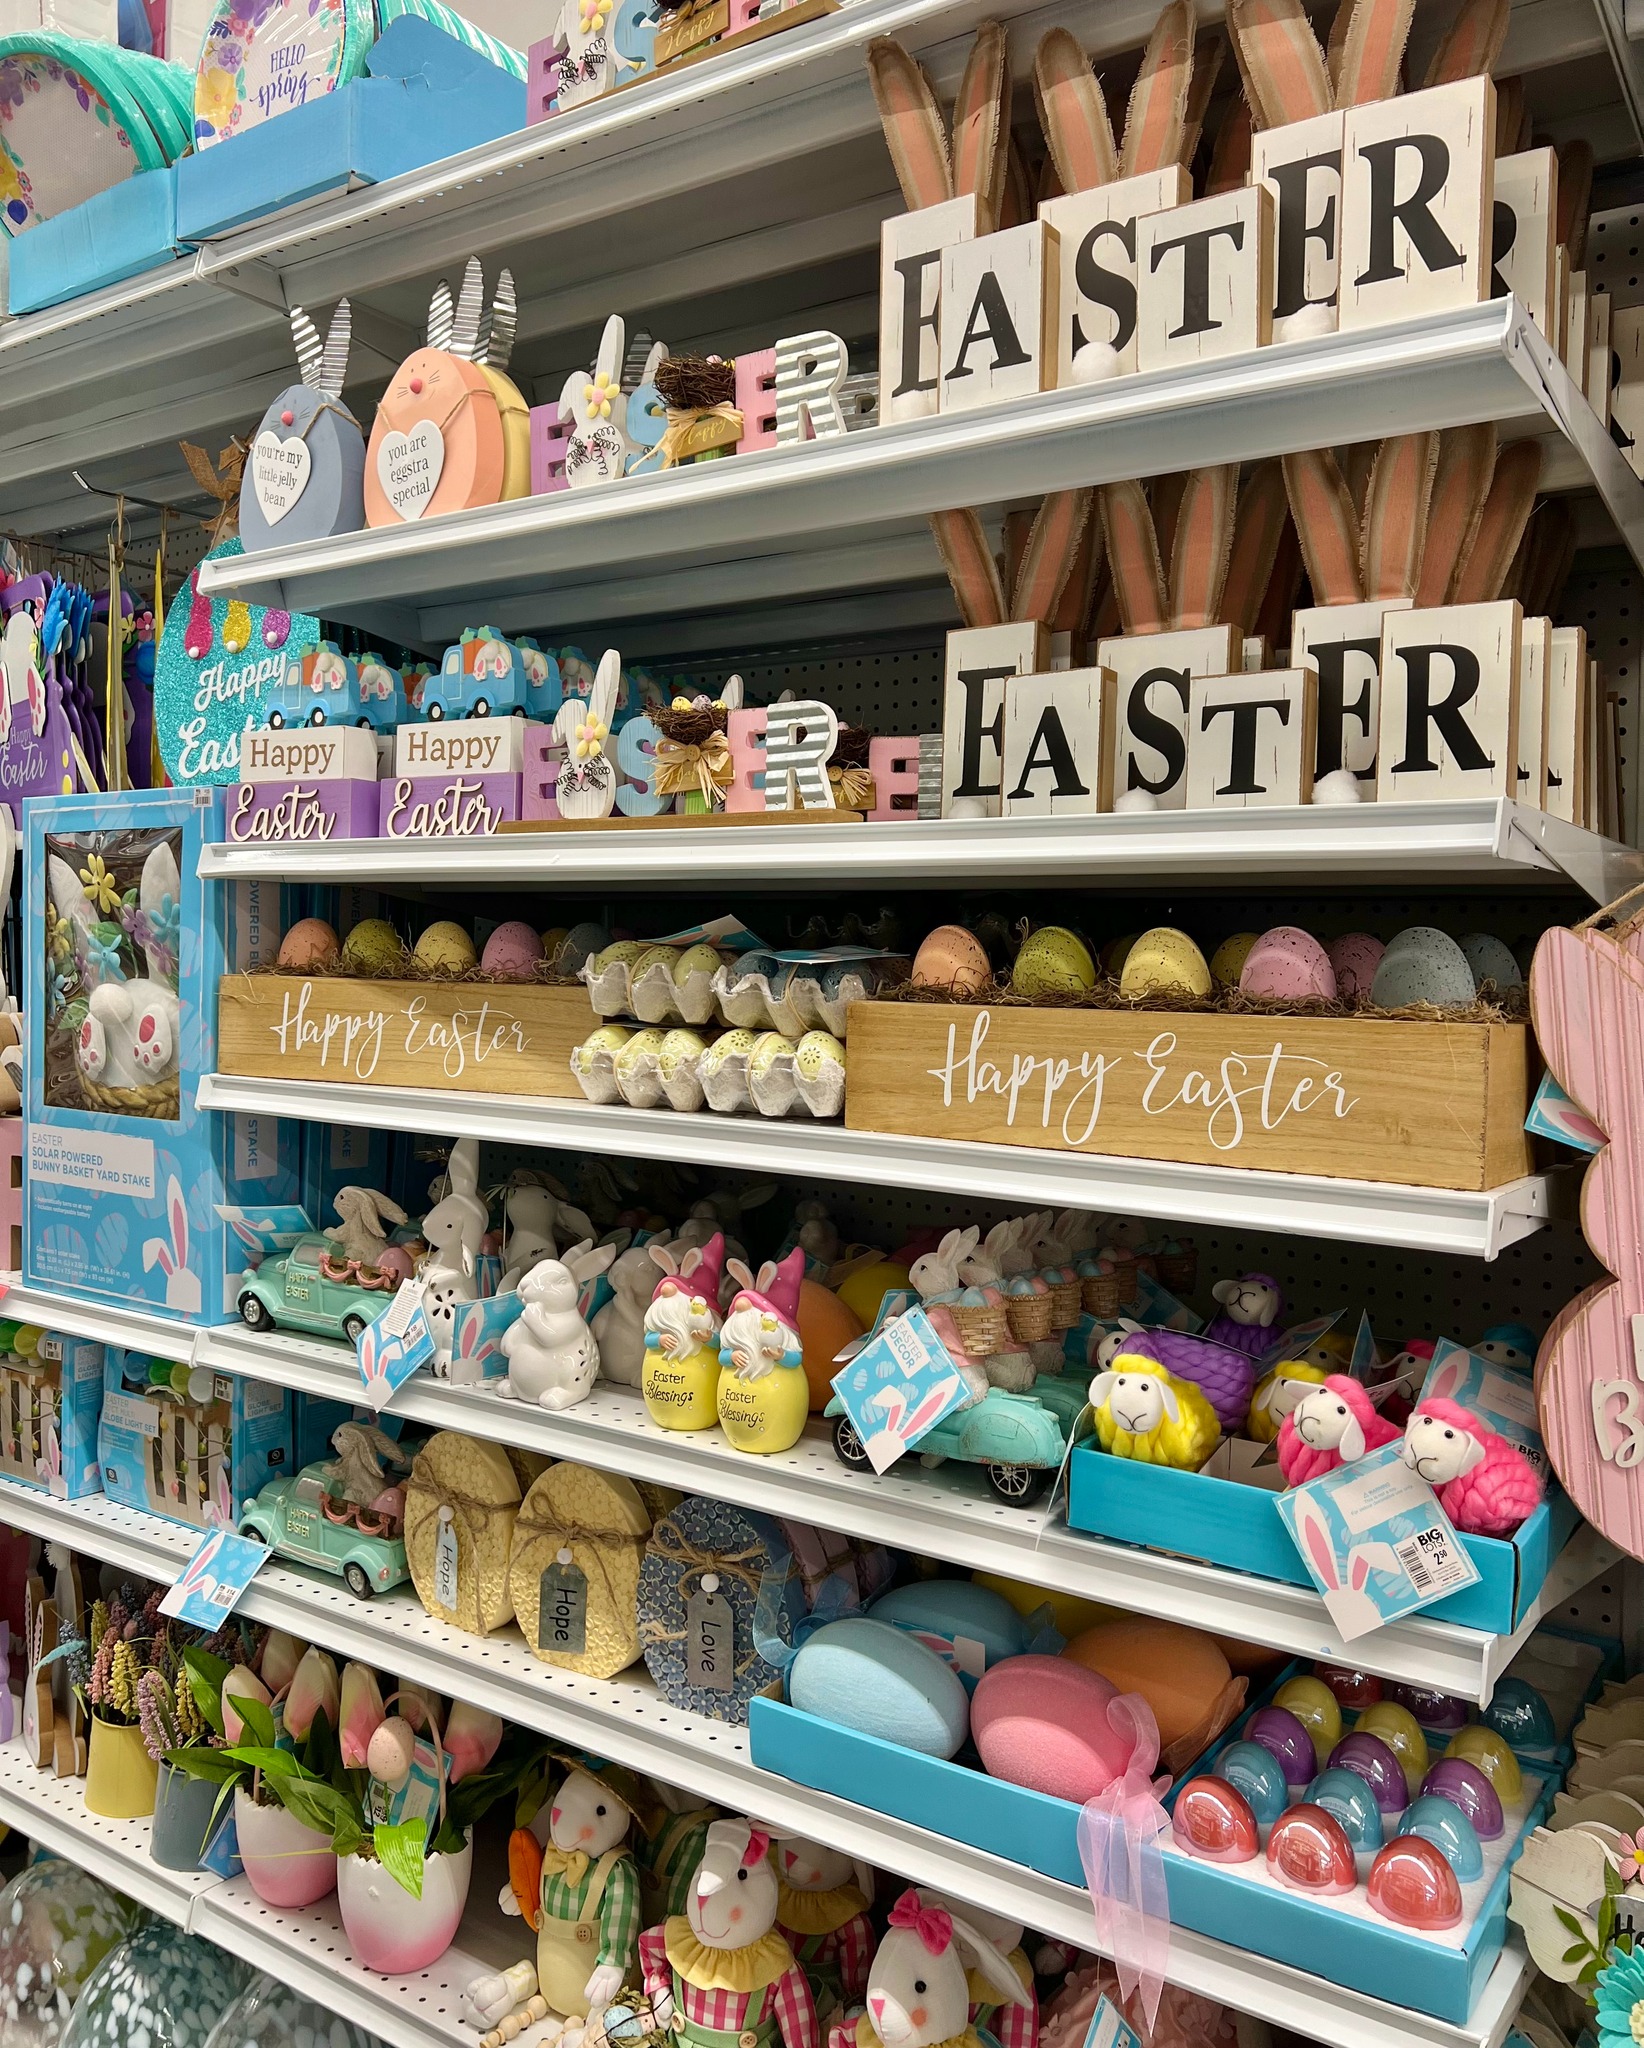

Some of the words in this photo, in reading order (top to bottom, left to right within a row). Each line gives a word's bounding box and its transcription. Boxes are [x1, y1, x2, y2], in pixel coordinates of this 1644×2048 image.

[665, 11, 716, 56] Happy
[270, 43, 306, 74] HELLO
[249, 68, 321, 117] spring
[894, 134, 1468, 399] EASTER
[255, 443, 285, 462] you're
[286, 450, 303, 469] my
[387, 443, 408, 467] you
[409, 435, 428, 454] are
[258, 464, 278, 482] little
[277, 468, 298, 490] jelly
[390, 457, 429, 485] eggstra
[263, 487, 286, 508] bean
[392, 476, 431, 508] special
[193, 651, 287, 713] Happy
[952, 637, 1497, 798] EASTER
[10, 726, 31, 748] Happy
[177, 713, 273, 780] Eas
[407, 731, 501, 769] Happy
[0, 741, 49, 790] Easter
[249, 738, 337, 775] Happy
[229, 784, 337, 842] Easter
[386, 777, 503, 838] Easter
[268, 981, 394, 1079] Happy
[400, 995, 532, 1080] Easter
[926, 1010, 1122, 1145] Happy
[1132, 1031, 1361, 1150] Easter
[32, 1132, 63, 1147] EASTER
[247, 1119, 258, 1168] STAKE
[32, 1146, 59, 1160] SOLAR
[61, 1151, 103, 1166] POWERED
[32, 1159, 61, 1173] BUNNY
[62, 1164, 94, 1178] BASKET
[97, 1169, 120, 1183] YARD
[122, 1174, 151, 1188] STAKE
[285, 1286, 310, 1301] EASTER
[288, 1272, 309, 1284] HAPPY
[889, 1329, 915, 1369] DECOR
[896, 1322, 923, 1361] EASTER
[653, 1369, 686, 1385] Easter
[644, 1380, 694, 1407] Blessings
[725, 1388, 757, 1404] Easter
[144, 1423, 156, 1434] SET
[718, 1398, 766, 1428] Blessings
[1518, 1444, 1541, 1460] BIG
[286, 1520, 310, 1538] EASTER
[290, 1507, 309, 1521] HAPPY
[1417, 1528, 1441, 1546] BIG
[442, 1544, 453, 1596] Hope
[554, 1587, 578, 1642] Hope
[701, 1620, 722, 1673] Love
